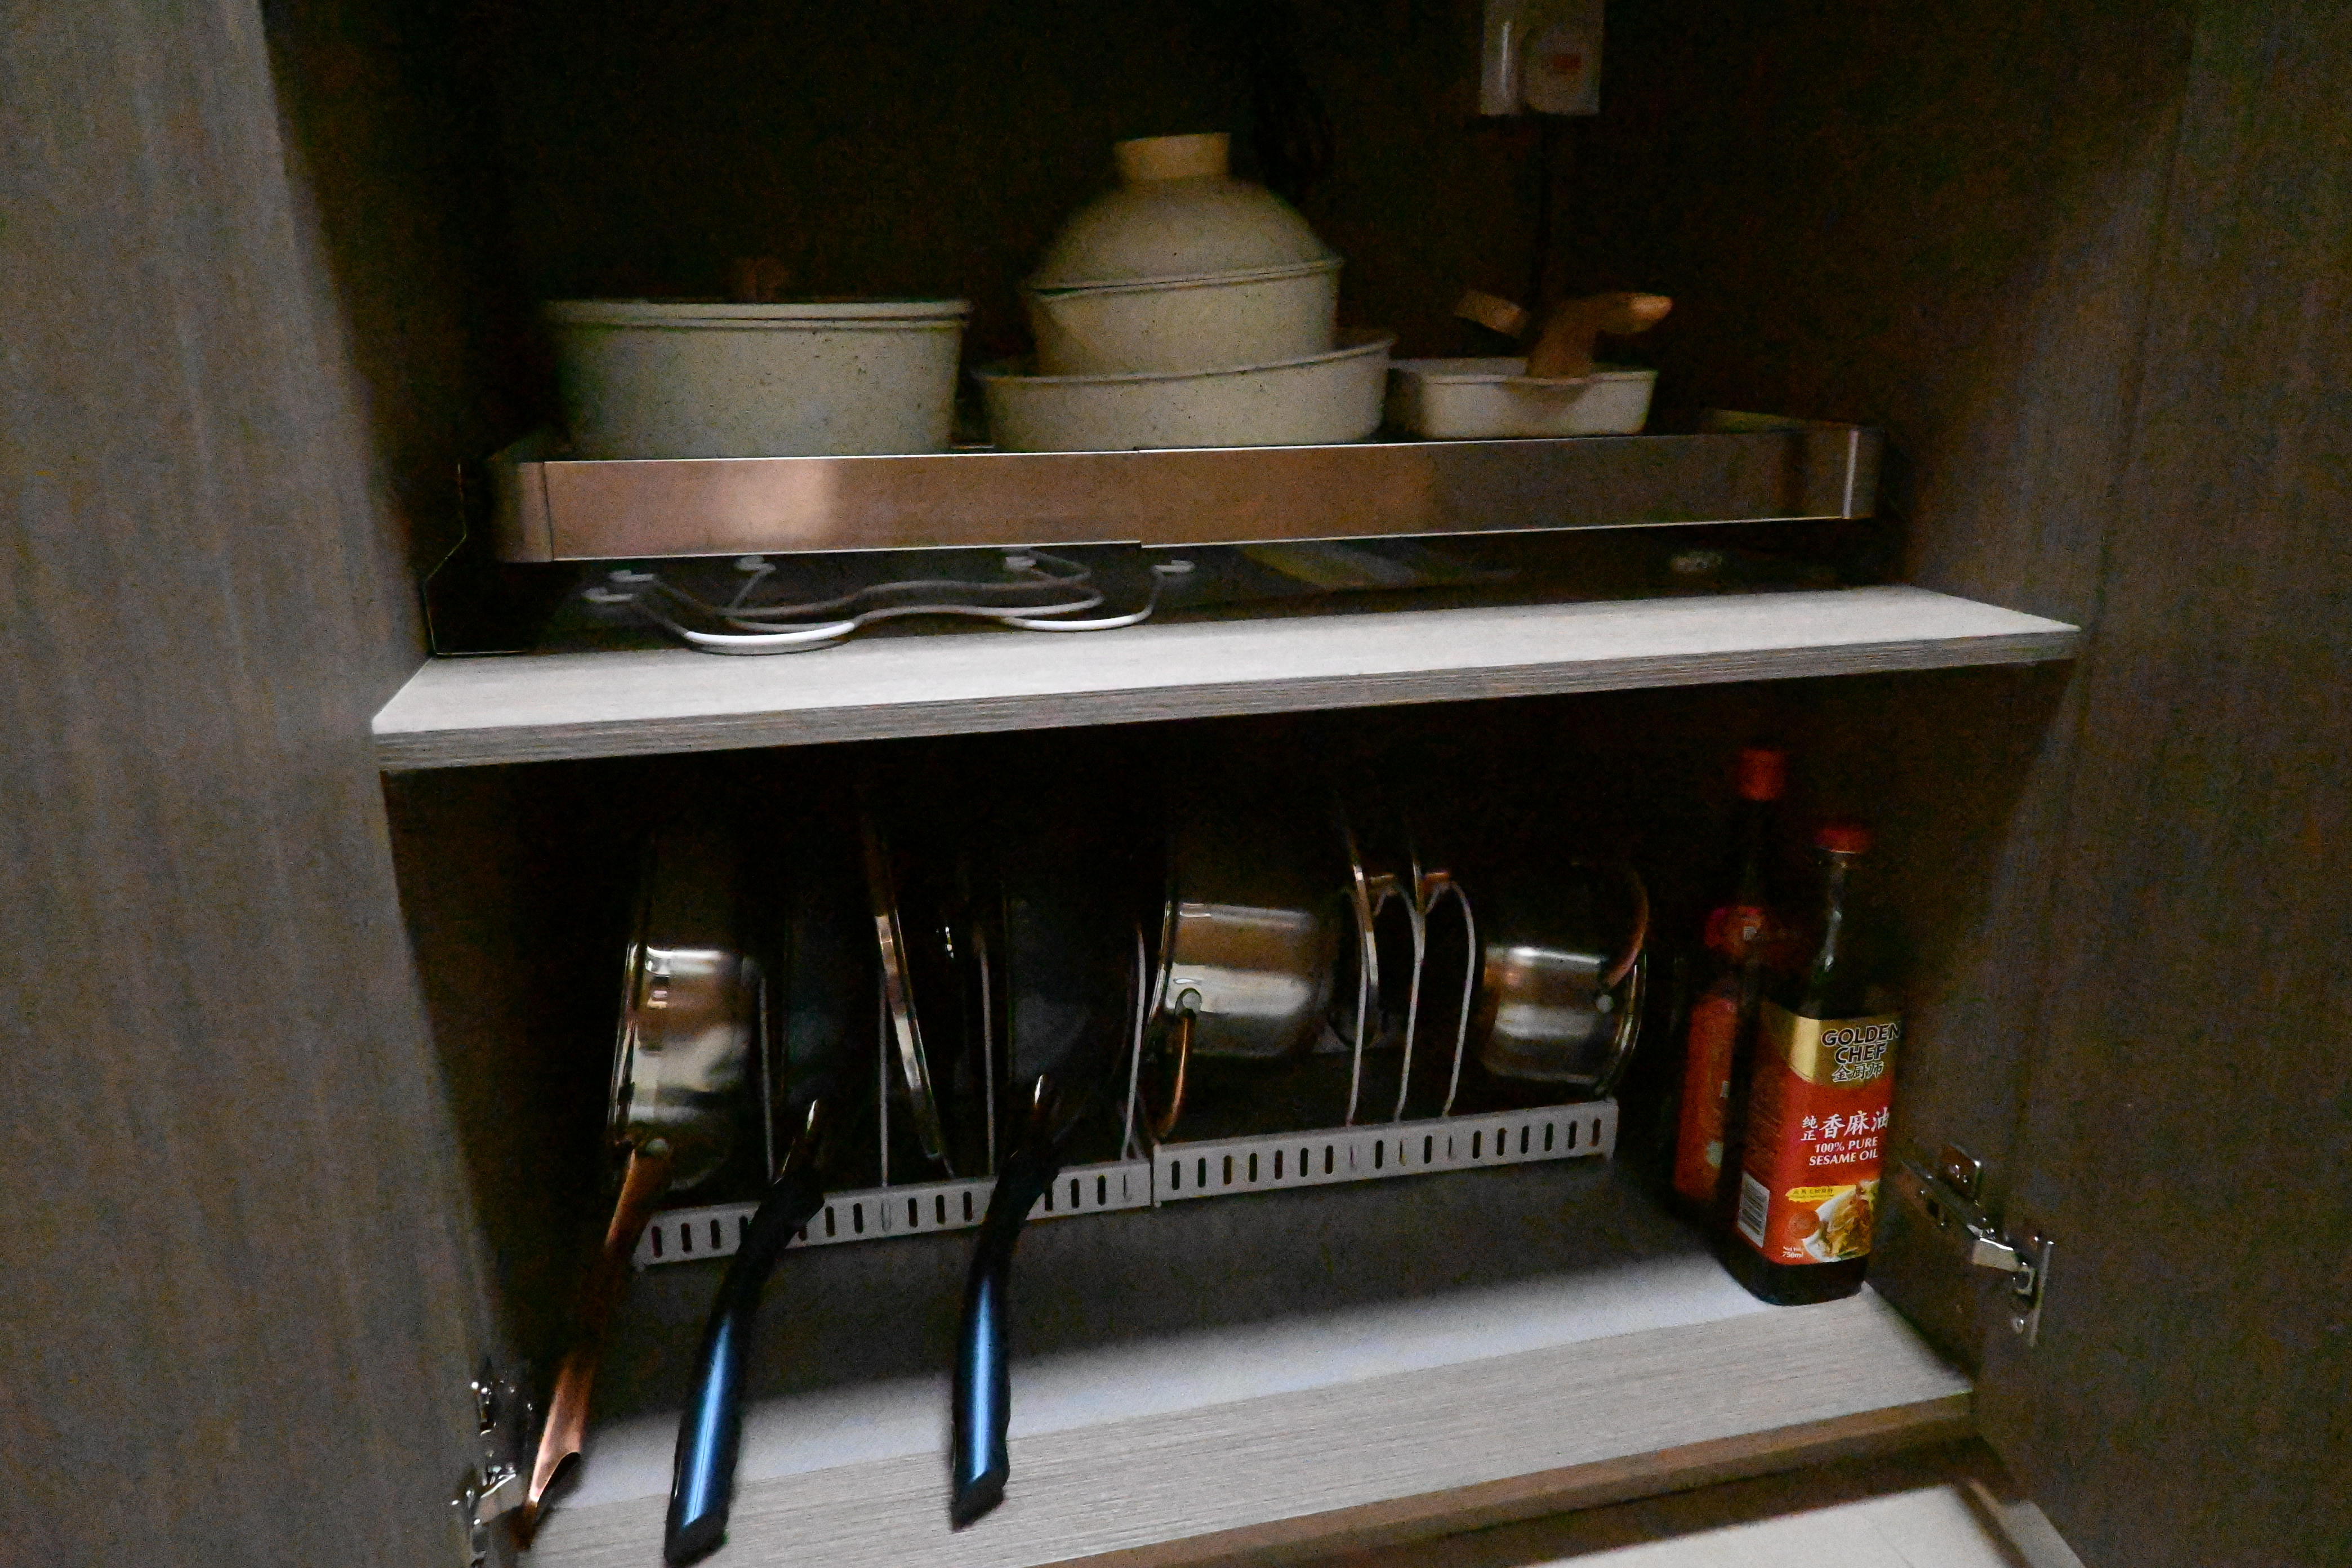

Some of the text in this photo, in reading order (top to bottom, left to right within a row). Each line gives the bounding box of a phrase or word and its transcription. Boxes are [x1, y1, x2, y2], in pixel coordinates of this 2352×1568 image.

[1821, 1022, 1900, 1047] GOLDEN
[1834, 1041, 1887, 1064] CHEF
[1832, 1061, 1885, 1083] 金厨师
[1814, 1136, 1878, 1153] 100% PURE
[1808, 1148, 1878, 1166] SESAME OIL
